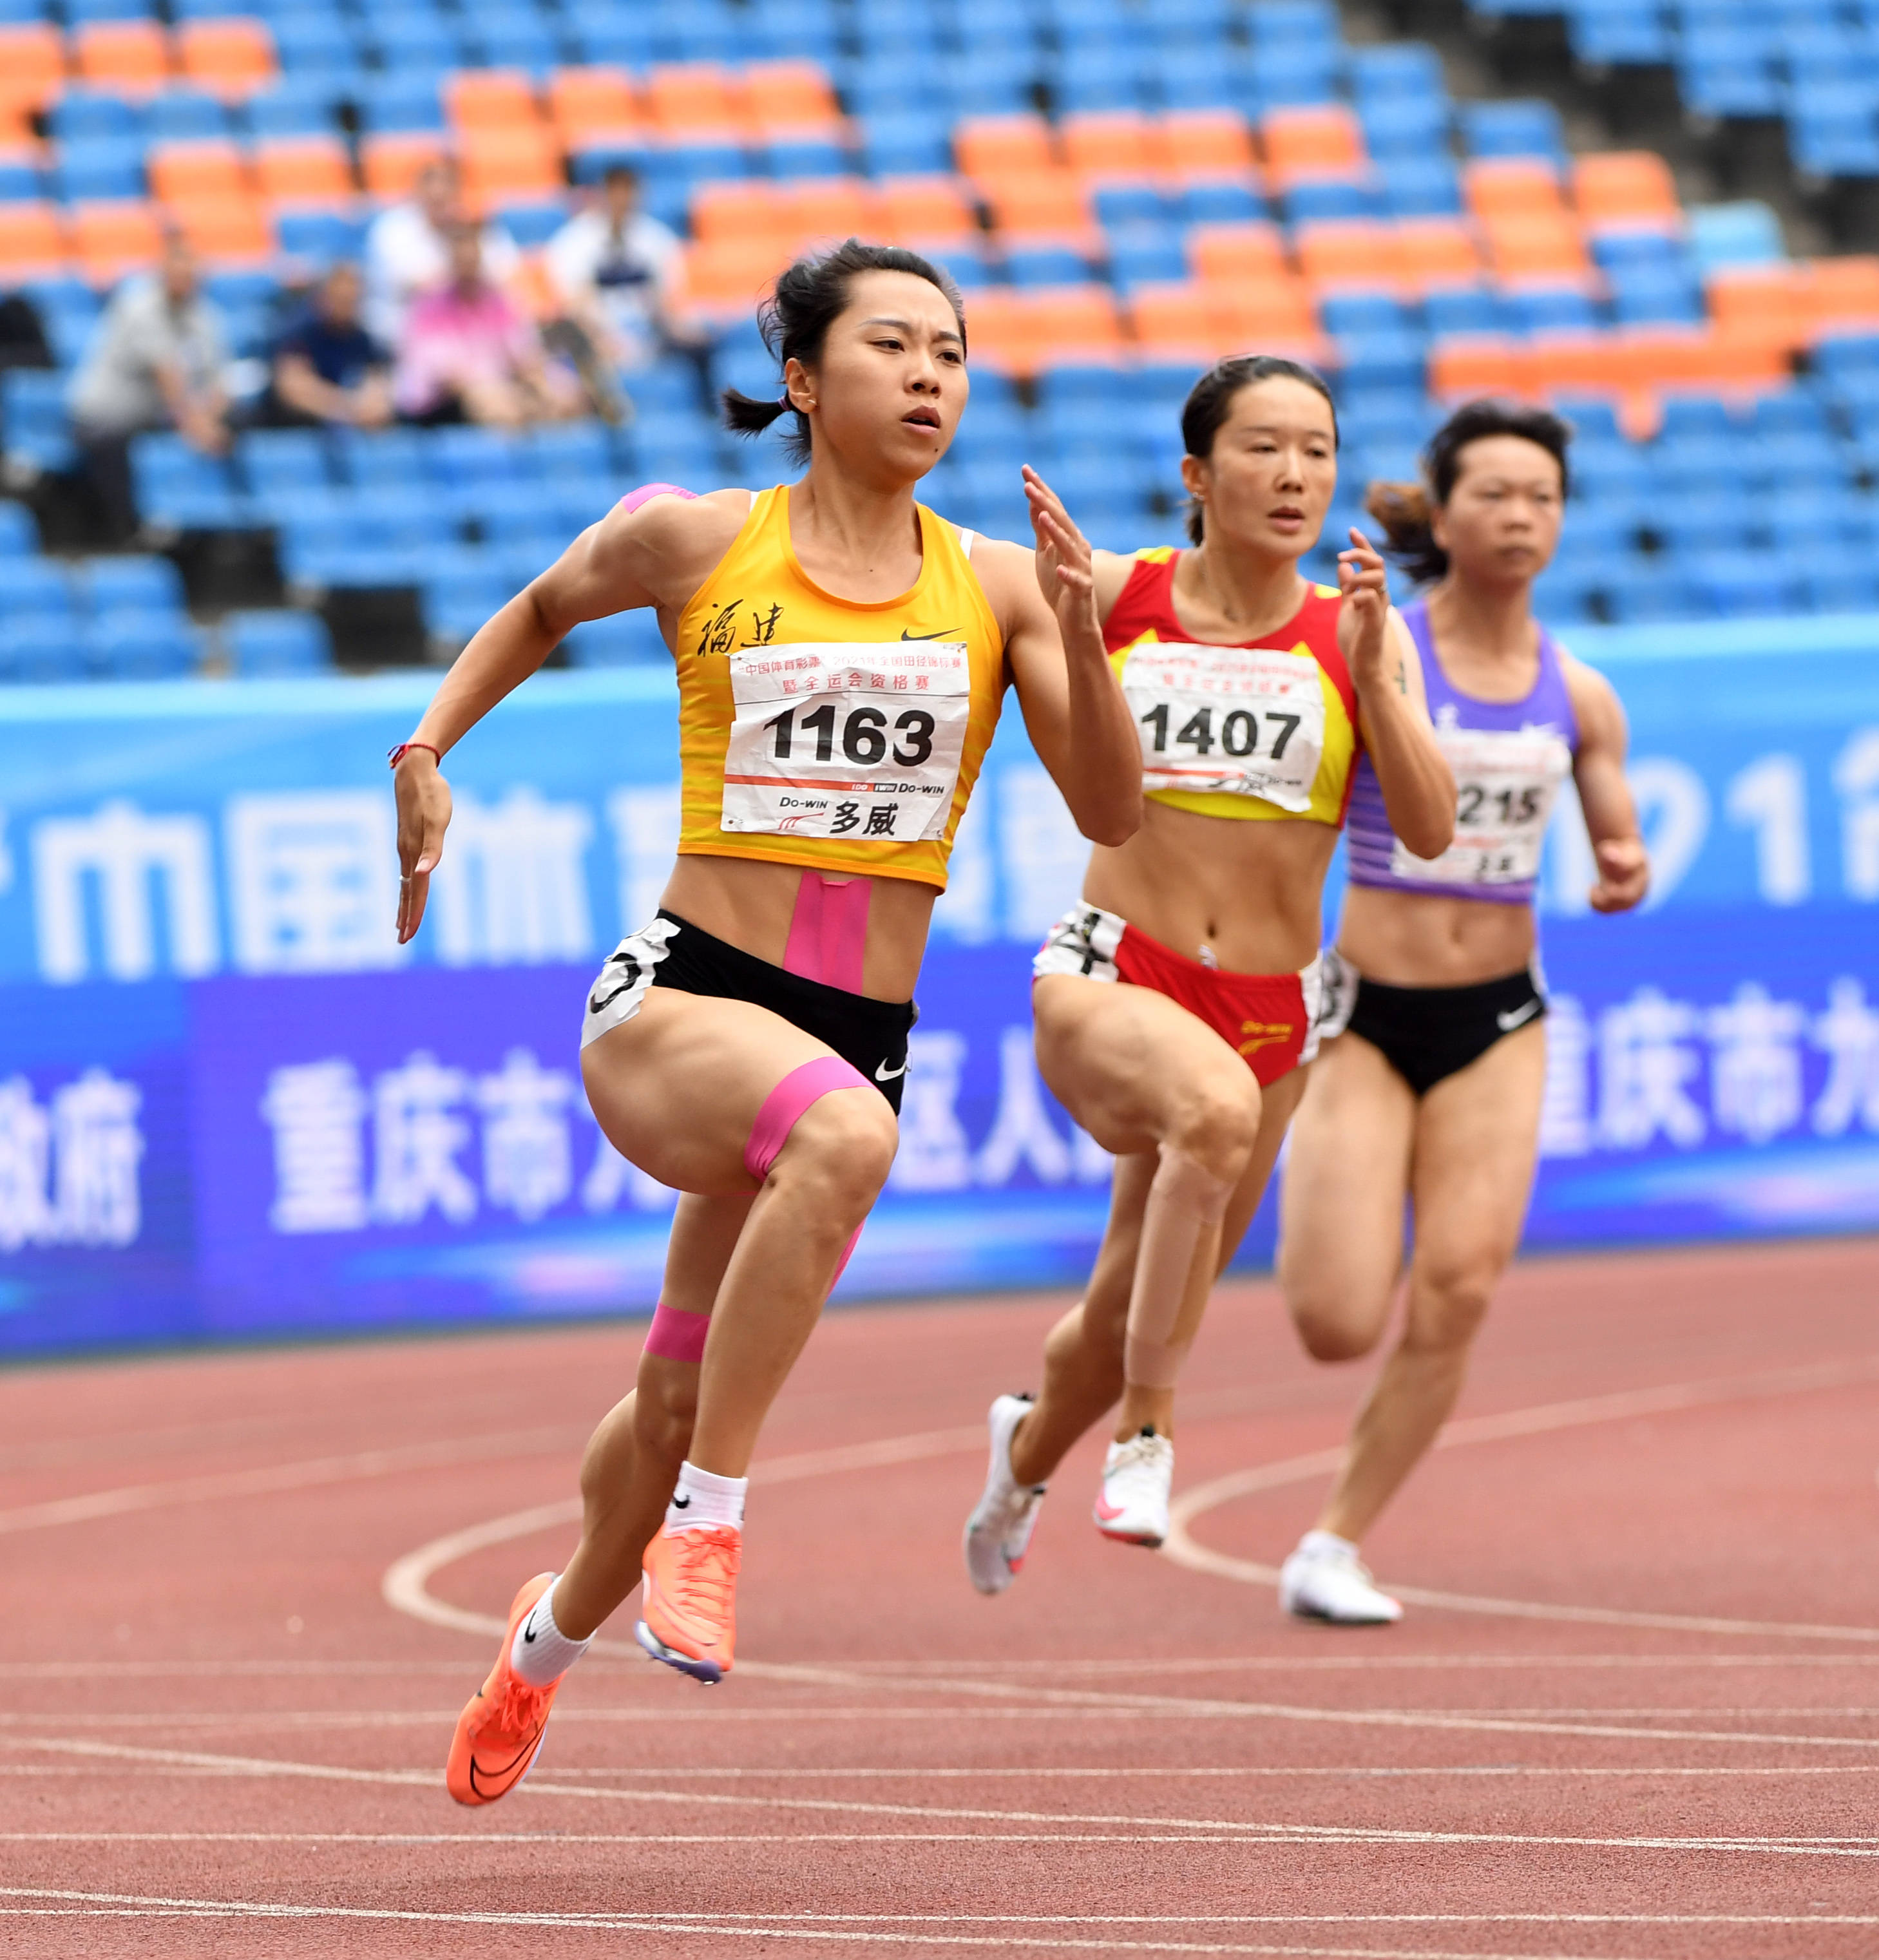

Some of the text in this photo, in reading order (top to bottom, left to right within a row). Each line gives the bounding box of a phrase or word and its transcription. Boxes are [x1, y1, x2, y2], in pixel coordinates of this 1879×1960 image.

[783, 671, 930, 695] 暨全运会资格赛
[763, 705, 935, 767] 1163
[1141, 703, 1301, 759] 1407
[829, 801, 899, 836] 多威
[1457, 782, 1543, 826] 215
